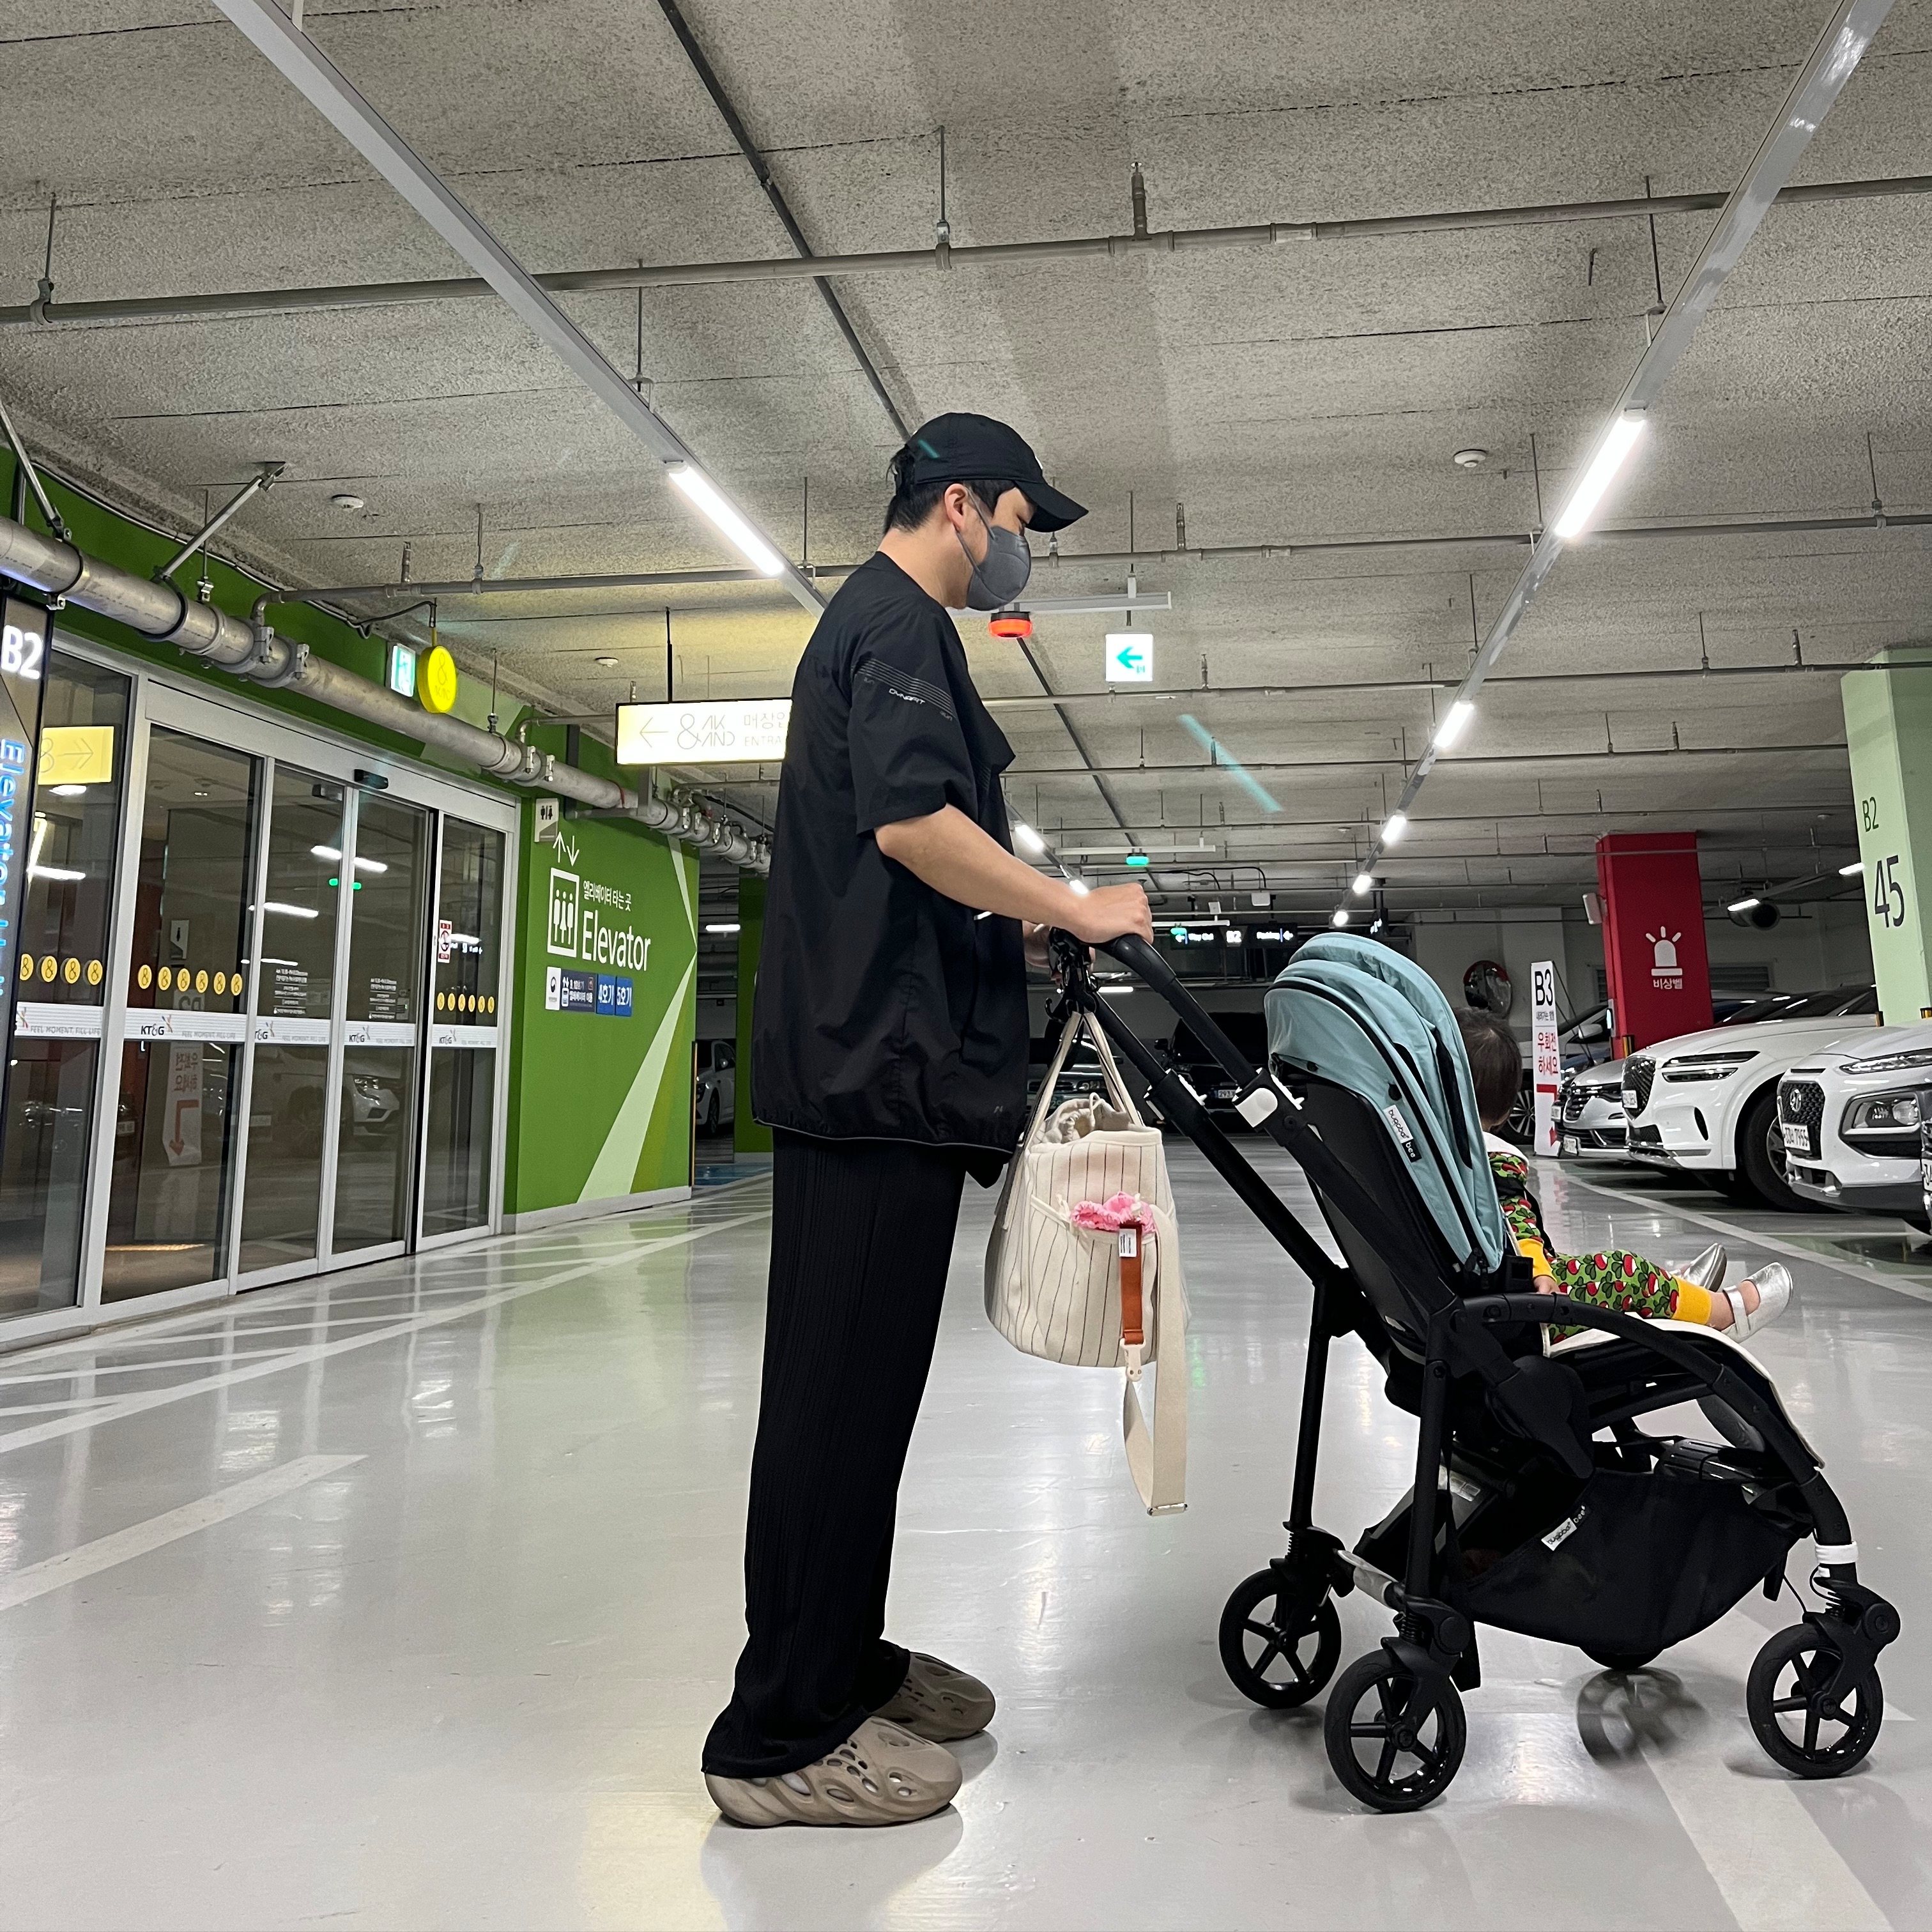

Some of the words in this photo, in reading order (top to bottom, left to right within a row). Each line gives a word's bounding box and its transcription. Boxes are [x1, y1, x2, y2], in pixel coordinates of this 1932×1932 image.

[1, 625, 42, 680] B2
[744, 712, 785, 729] 매장
[744, 735, 782, 747] ENTRA
[1862, 797, 1879, 832] B2
[1874, 854, 1905, 928] 45
[582, 909, 650, 971] Elevator
[1535, 969, 1553, 1006] B3
[1653, 978, 1683, 990] 비상벨
[598, 984, 614, 1006] 4호기
[617, 986, 632, 1007] 5호기
[141, 1023, 164, 1036] KT&G
[1538, 1032, 1556, 1052] 우회전
[1538, 1055, 1558, 1075] 하세요
[1406, 1141, 1416, 1158] bee
